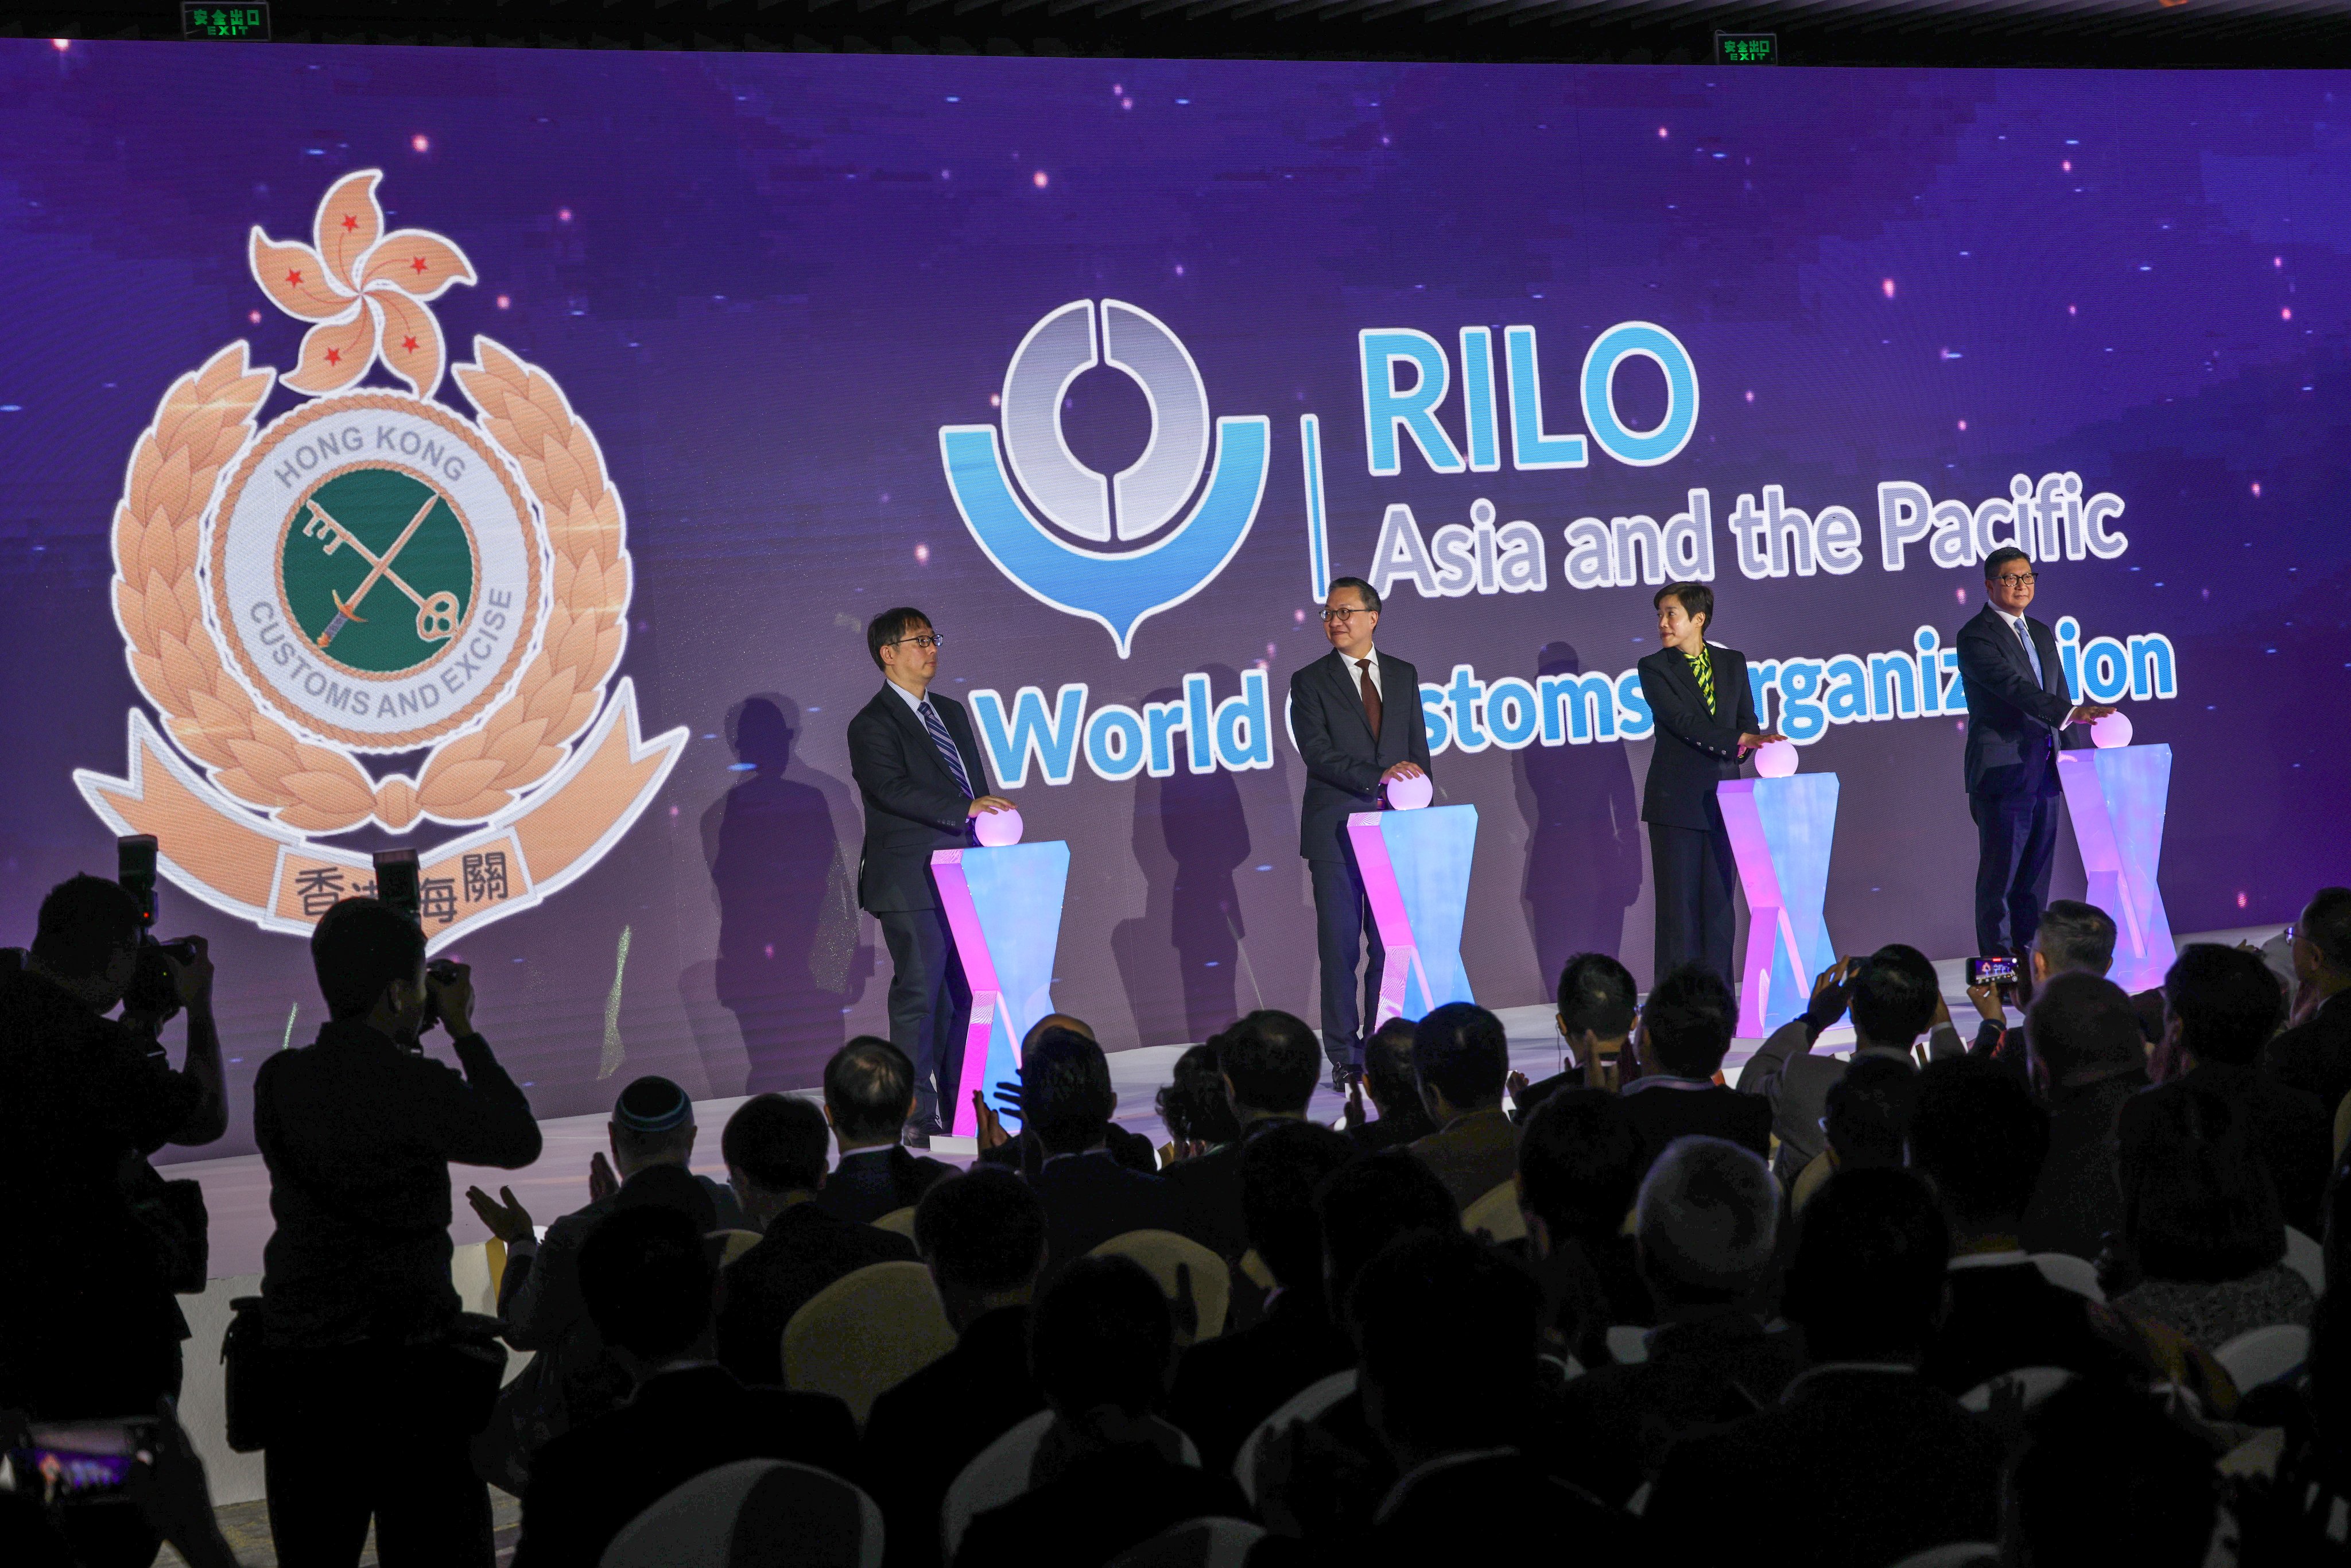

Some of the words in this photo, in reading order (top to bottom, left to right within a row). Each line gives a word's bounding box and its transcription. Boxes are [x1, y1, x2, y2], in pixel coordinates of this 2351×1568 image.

[193, 9, 260, 26] 安全出口
[207, 26, 249, 36] EXIT
[1724, 40, 1770, 53] 安全出口
[1731, 53, 1766, 61] EXIT
[1359, 320, 1700, 476] RILO
[274, 426, 364, 488] HONG
[377, 425, 466, 481] KONG
[1368, 498, 1547, 600] Asia
[1564, 488, 1715, 590] and
[1728, 484, 1863, 580] the
[1877, 471, 2128, 571] Pacific
[250, 600, 370, 717] CUSTOMS
[377, 683, 440, 719] AND
[441, 587, 511, 694] EXCISE
[968, 669, 1274, 790] World
[1285, 664, 1655, 756] stoms
[295, 851, 509, 923] 香海關
